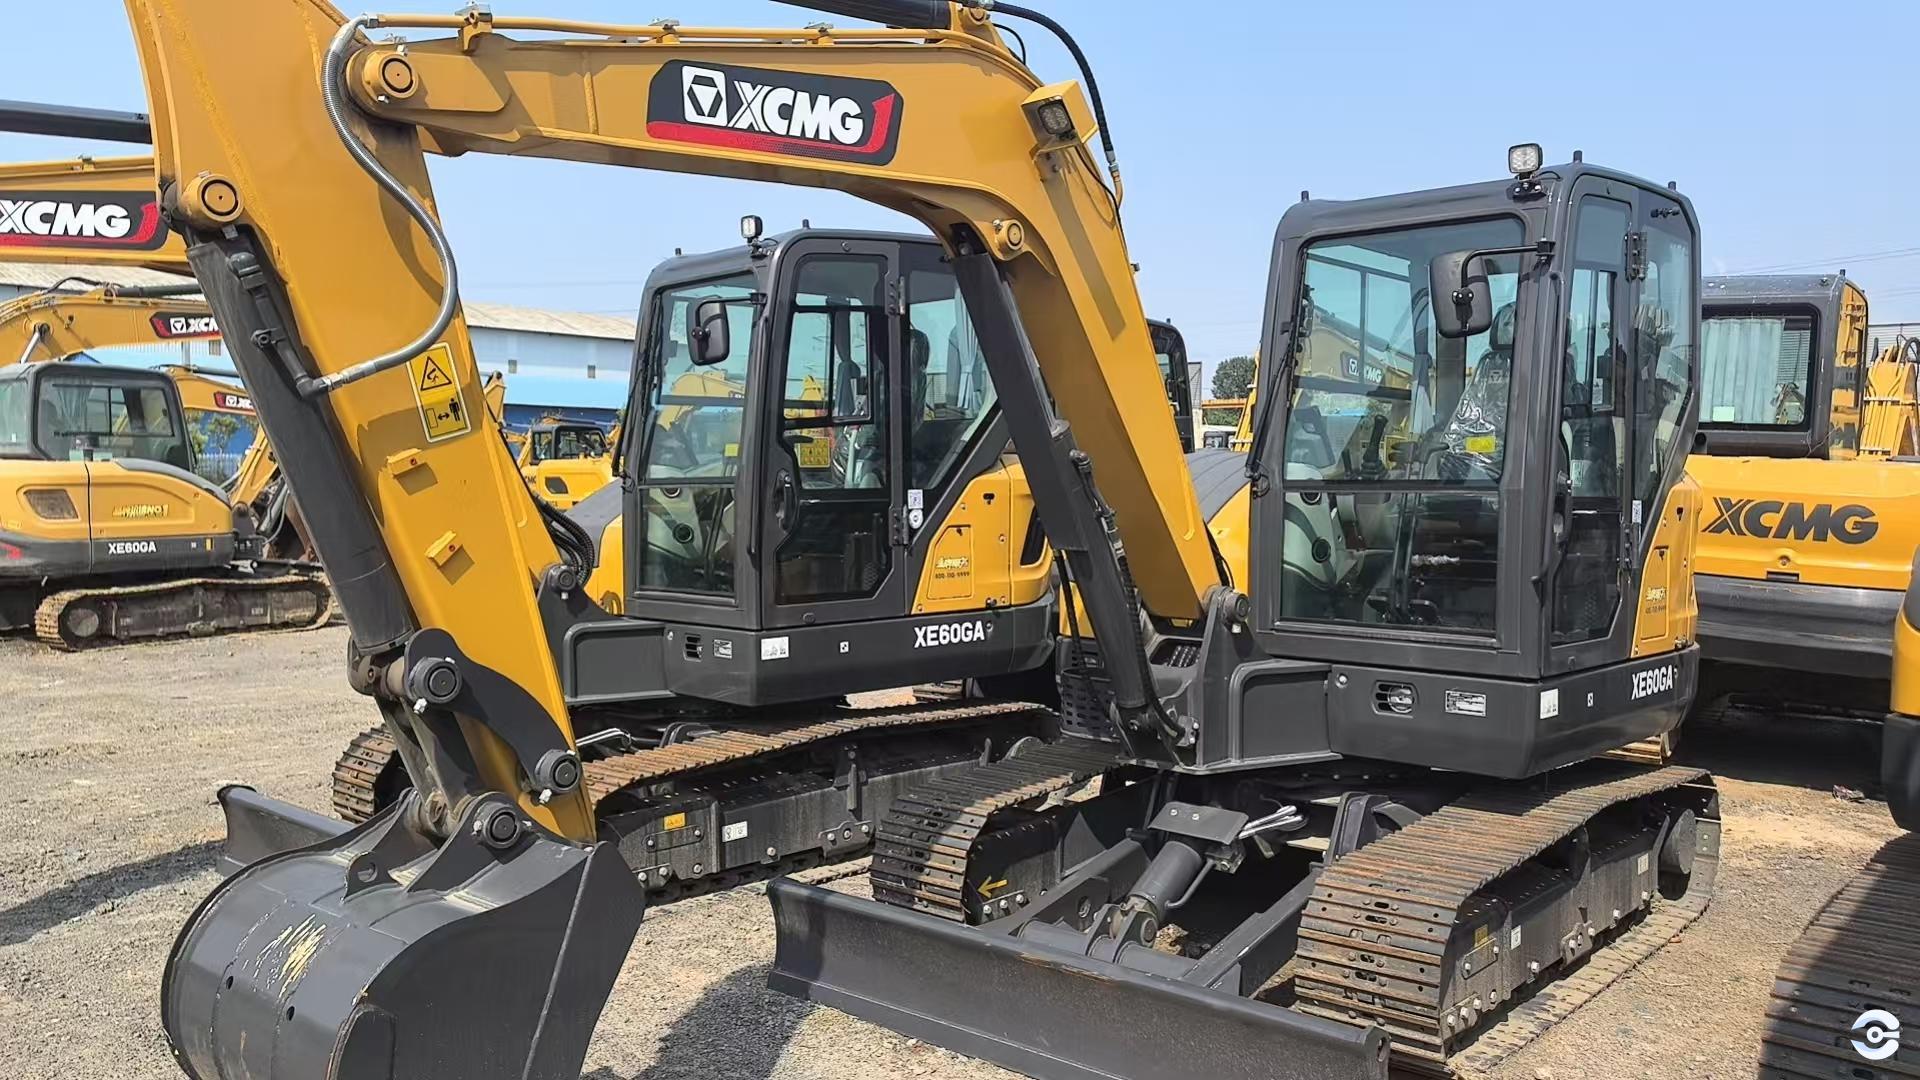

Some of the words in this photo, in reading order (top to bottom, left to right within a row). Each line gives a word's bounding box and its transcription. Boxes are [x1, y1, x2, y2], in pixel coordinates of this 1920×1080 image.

[727, 80, 864, 145] XCMG
[0, 200, 131, 238] XCMG
[1701, 496, 1879, 545] XCMG
[107, 540, 157, 555] XE60GA
[913, 619, 986, 649] XE60GA
[1631, 664, 1673, 700] XE60GA
